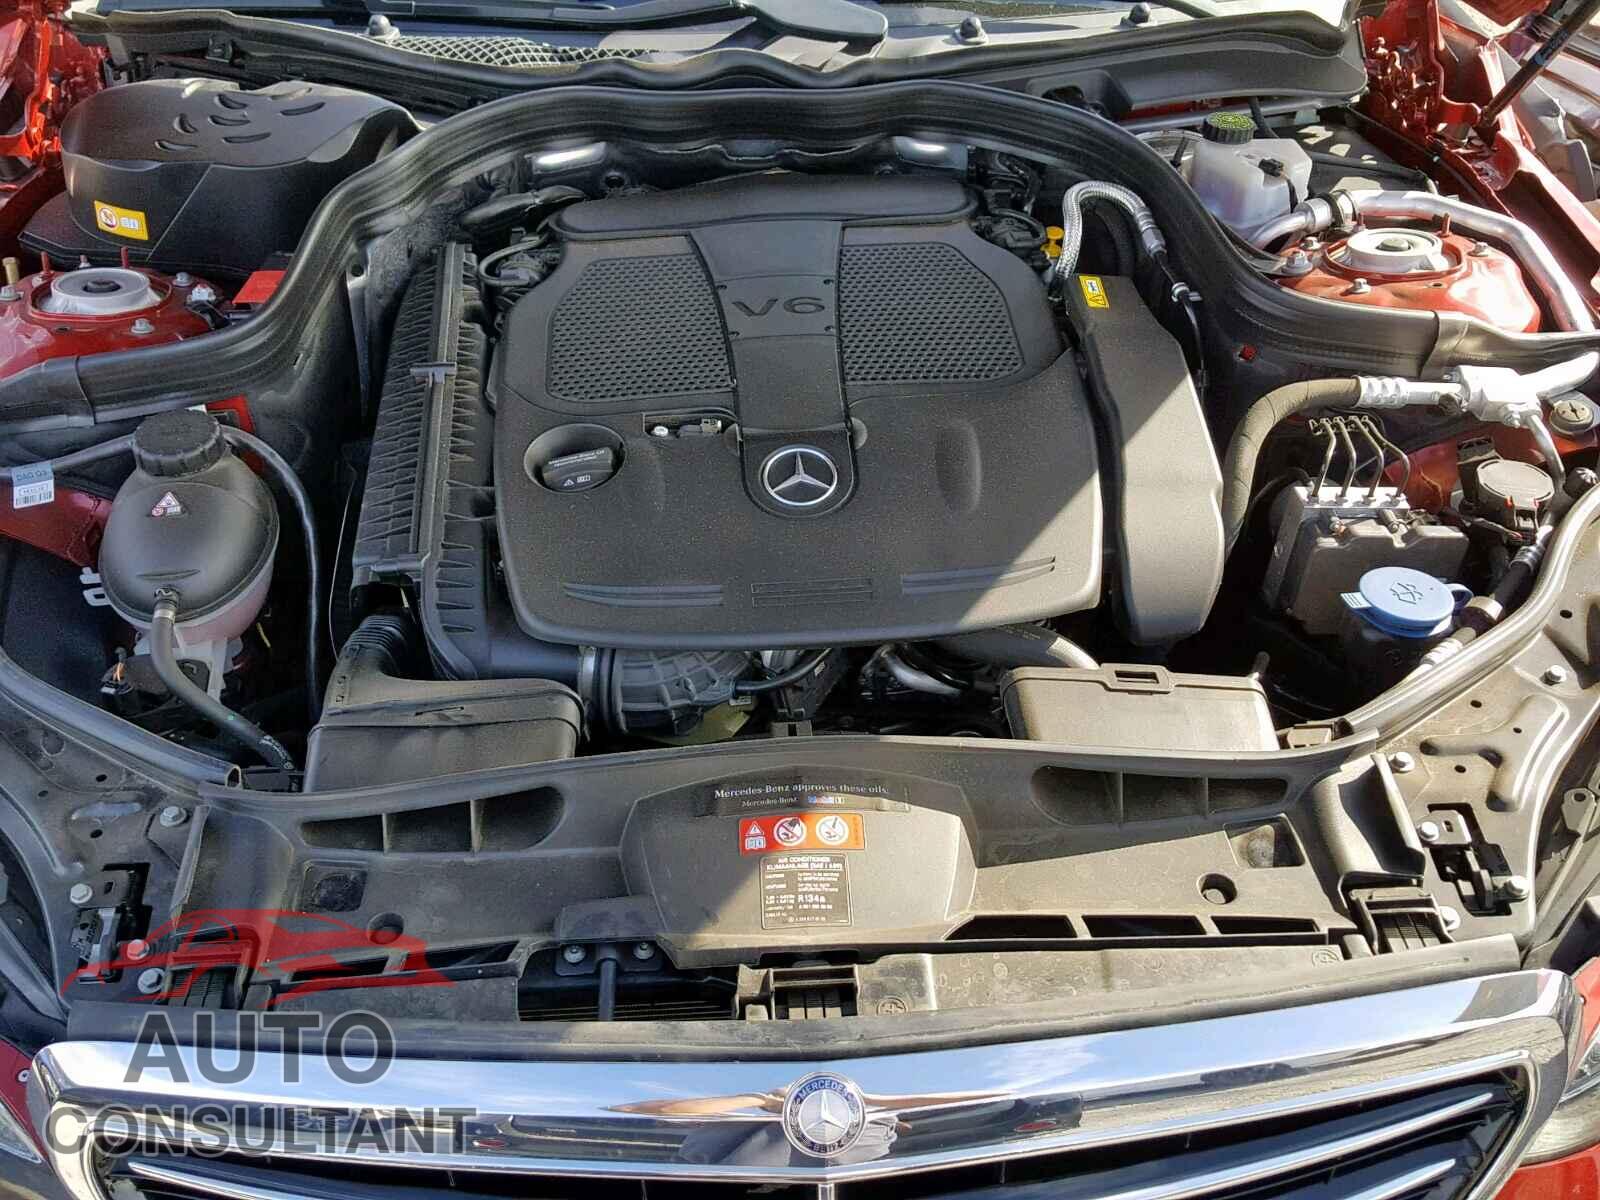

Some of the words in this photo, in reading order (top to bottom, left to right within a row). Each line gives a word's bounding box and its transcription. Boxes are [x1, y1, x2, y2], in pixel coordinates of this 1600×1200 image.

[731, 296, 825, 317] V6
[714, 784, 790, 799] Mercedes-Benz
[792, 783, 837, 793] approves
[840, 783, 866, 793] these
